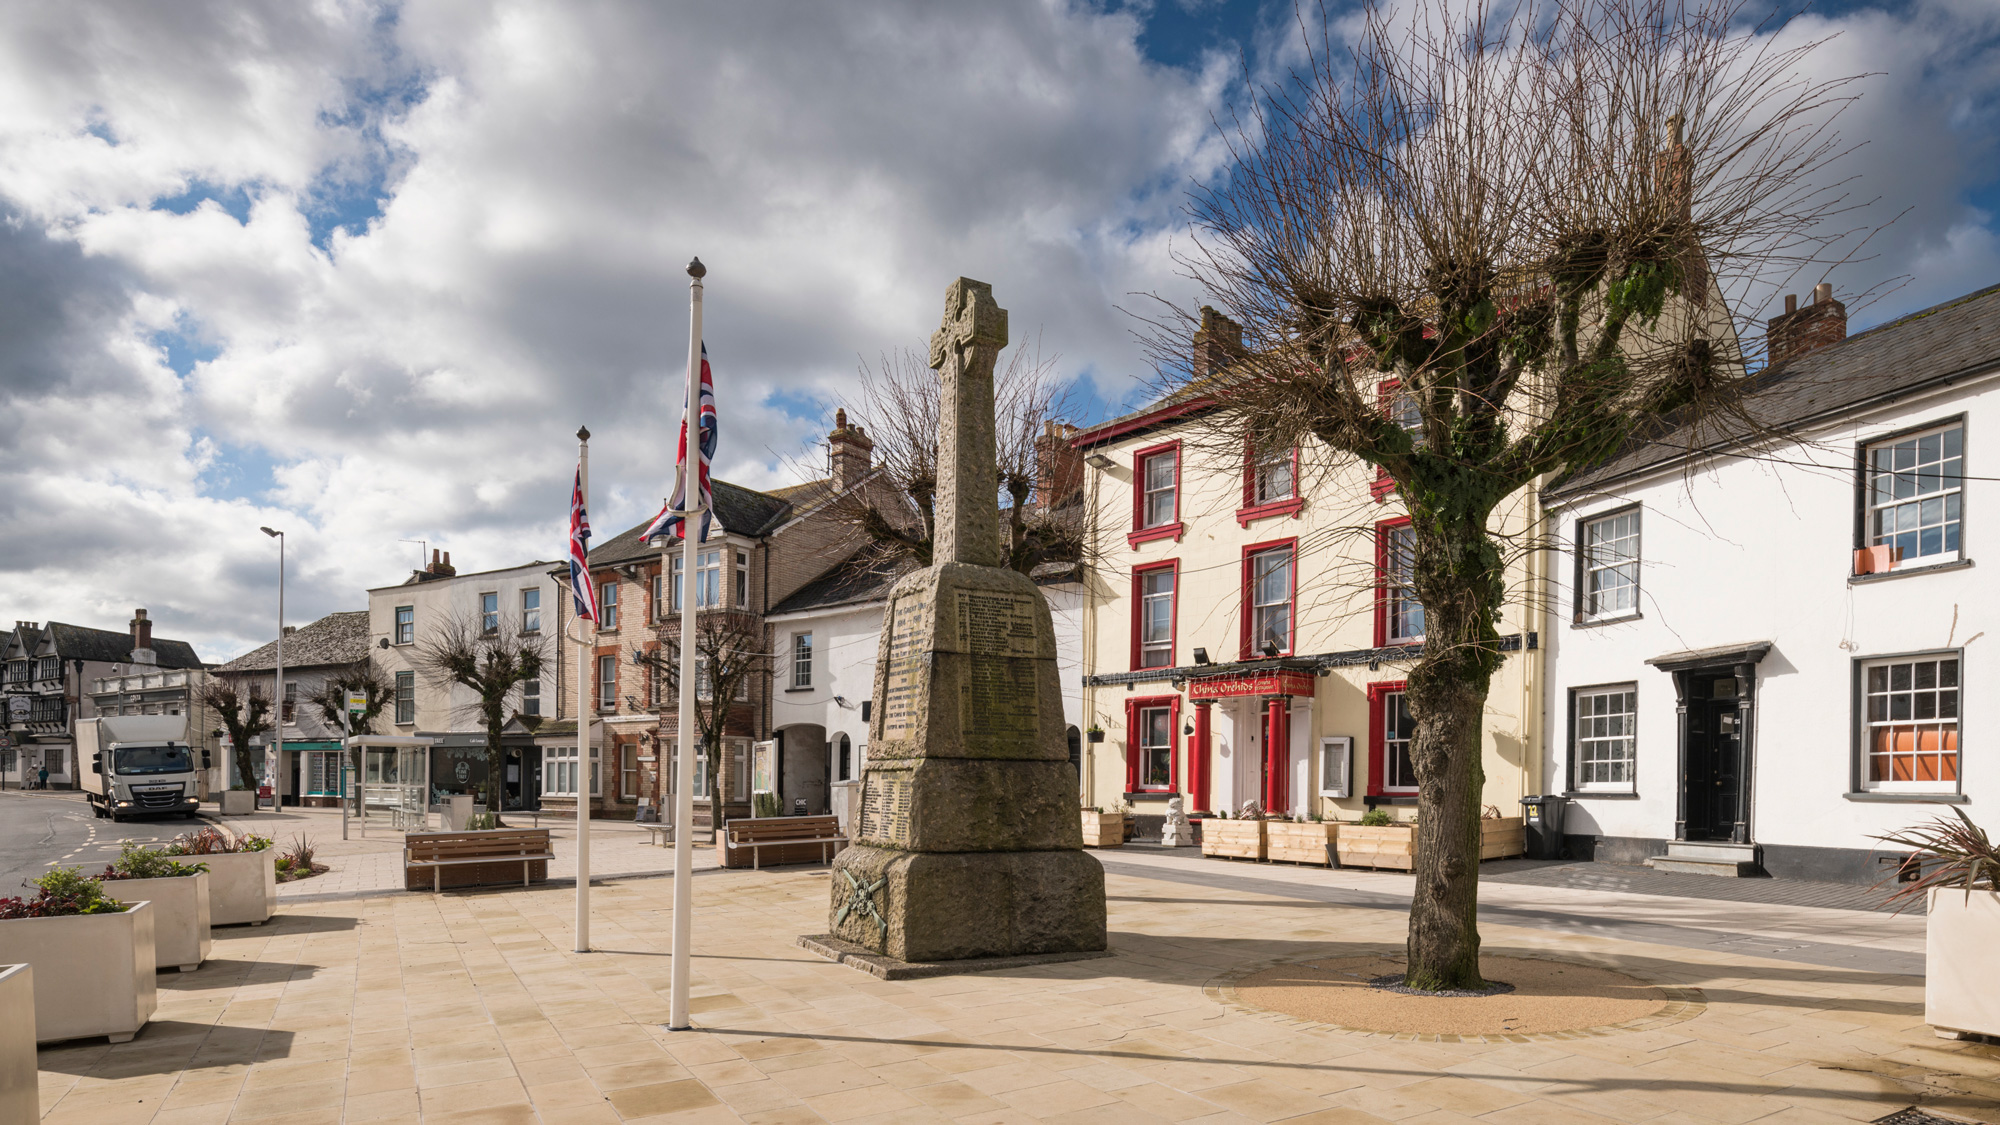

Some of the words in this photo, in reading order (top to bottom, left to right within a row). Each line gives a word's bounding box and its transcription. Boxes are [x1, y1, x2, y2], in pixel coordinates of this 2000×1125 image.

[1193, 683, 1218, 694] China
[1220, 681, 1253, 693] Orchids
[1528, 805, 1538, 816] 22
